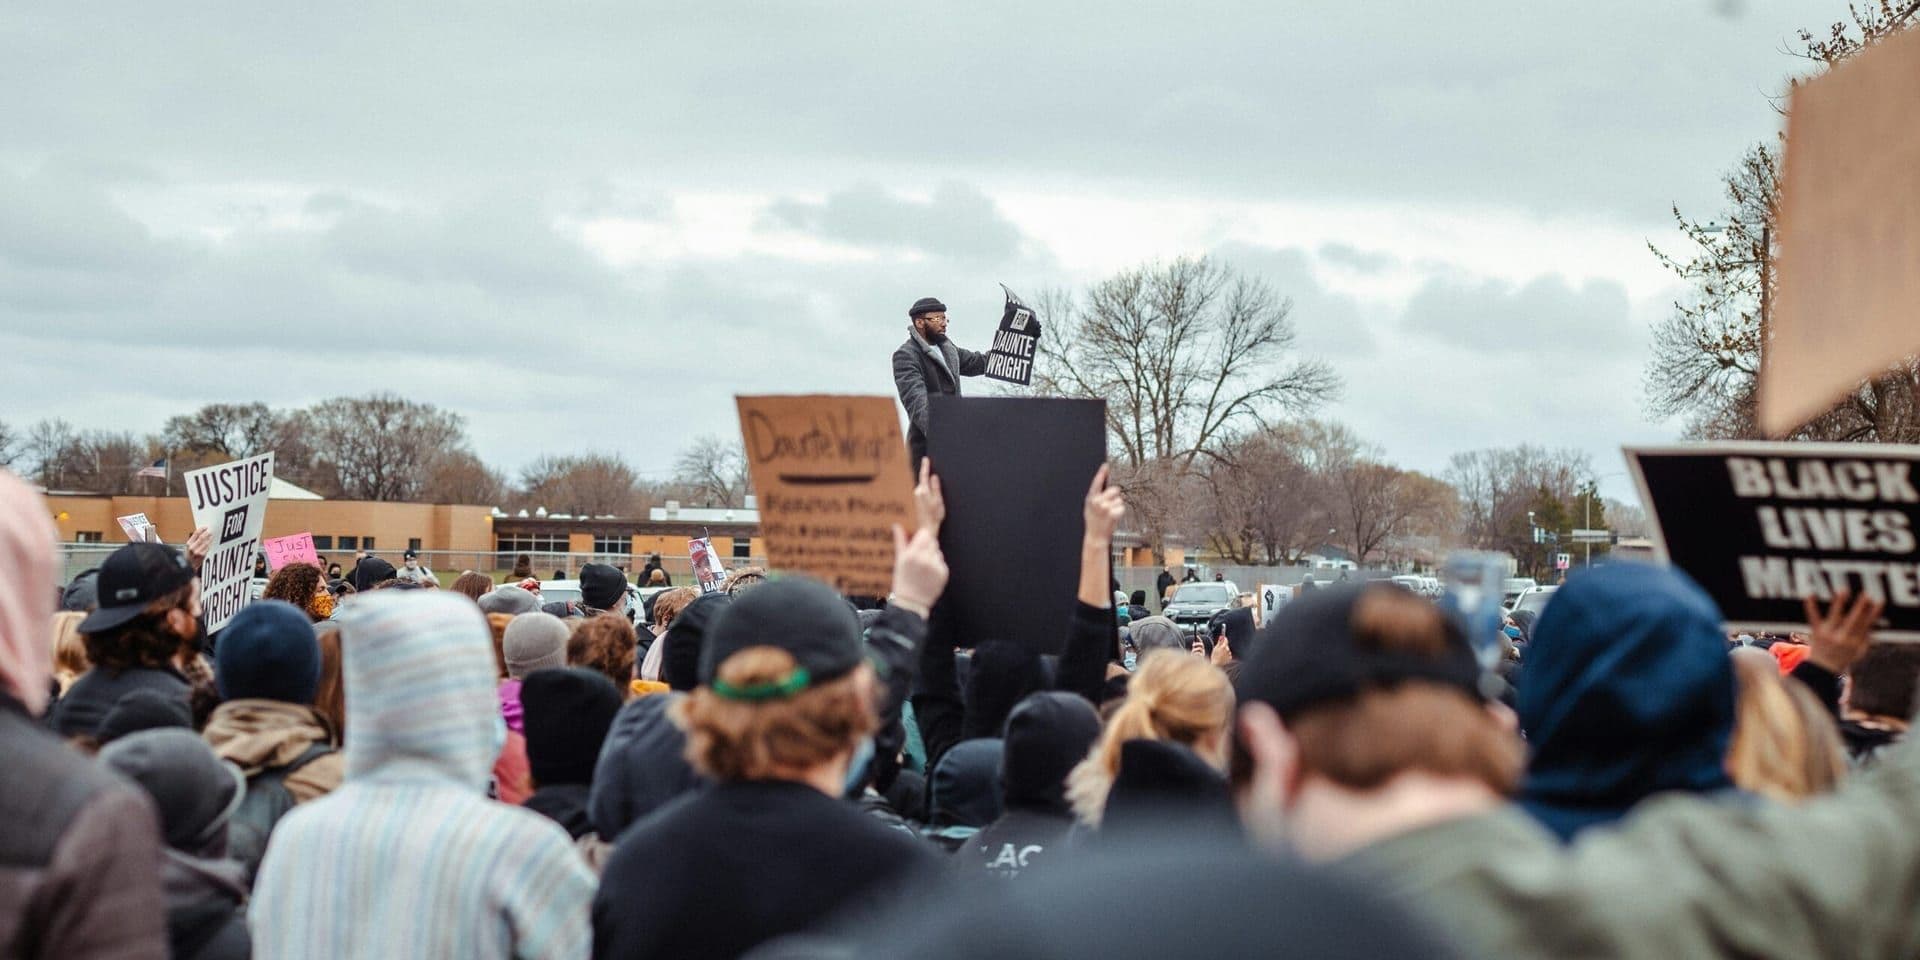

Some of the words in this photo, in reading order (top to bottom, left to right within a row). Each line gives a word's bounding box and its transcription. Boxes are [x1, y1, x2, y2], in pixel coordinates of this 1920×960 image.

[1013, 311, 1028, 327] FOR
[986, 352, 1030, 381] WRIGHT
[993, 329, 1034, 358] DAUNTE
[194, 458, 269, 510] JUSTICE
[1727, 457, 1919, 502] BLACK
[224, 511, 245, 538] FOR
[1757, 506, 1915, 553] LIVES
[203, 538, 257, 592] DAUNTE
[1738, 555, 1920, 608] MATTE
[202, 576, 250, 630] WRIGHT
